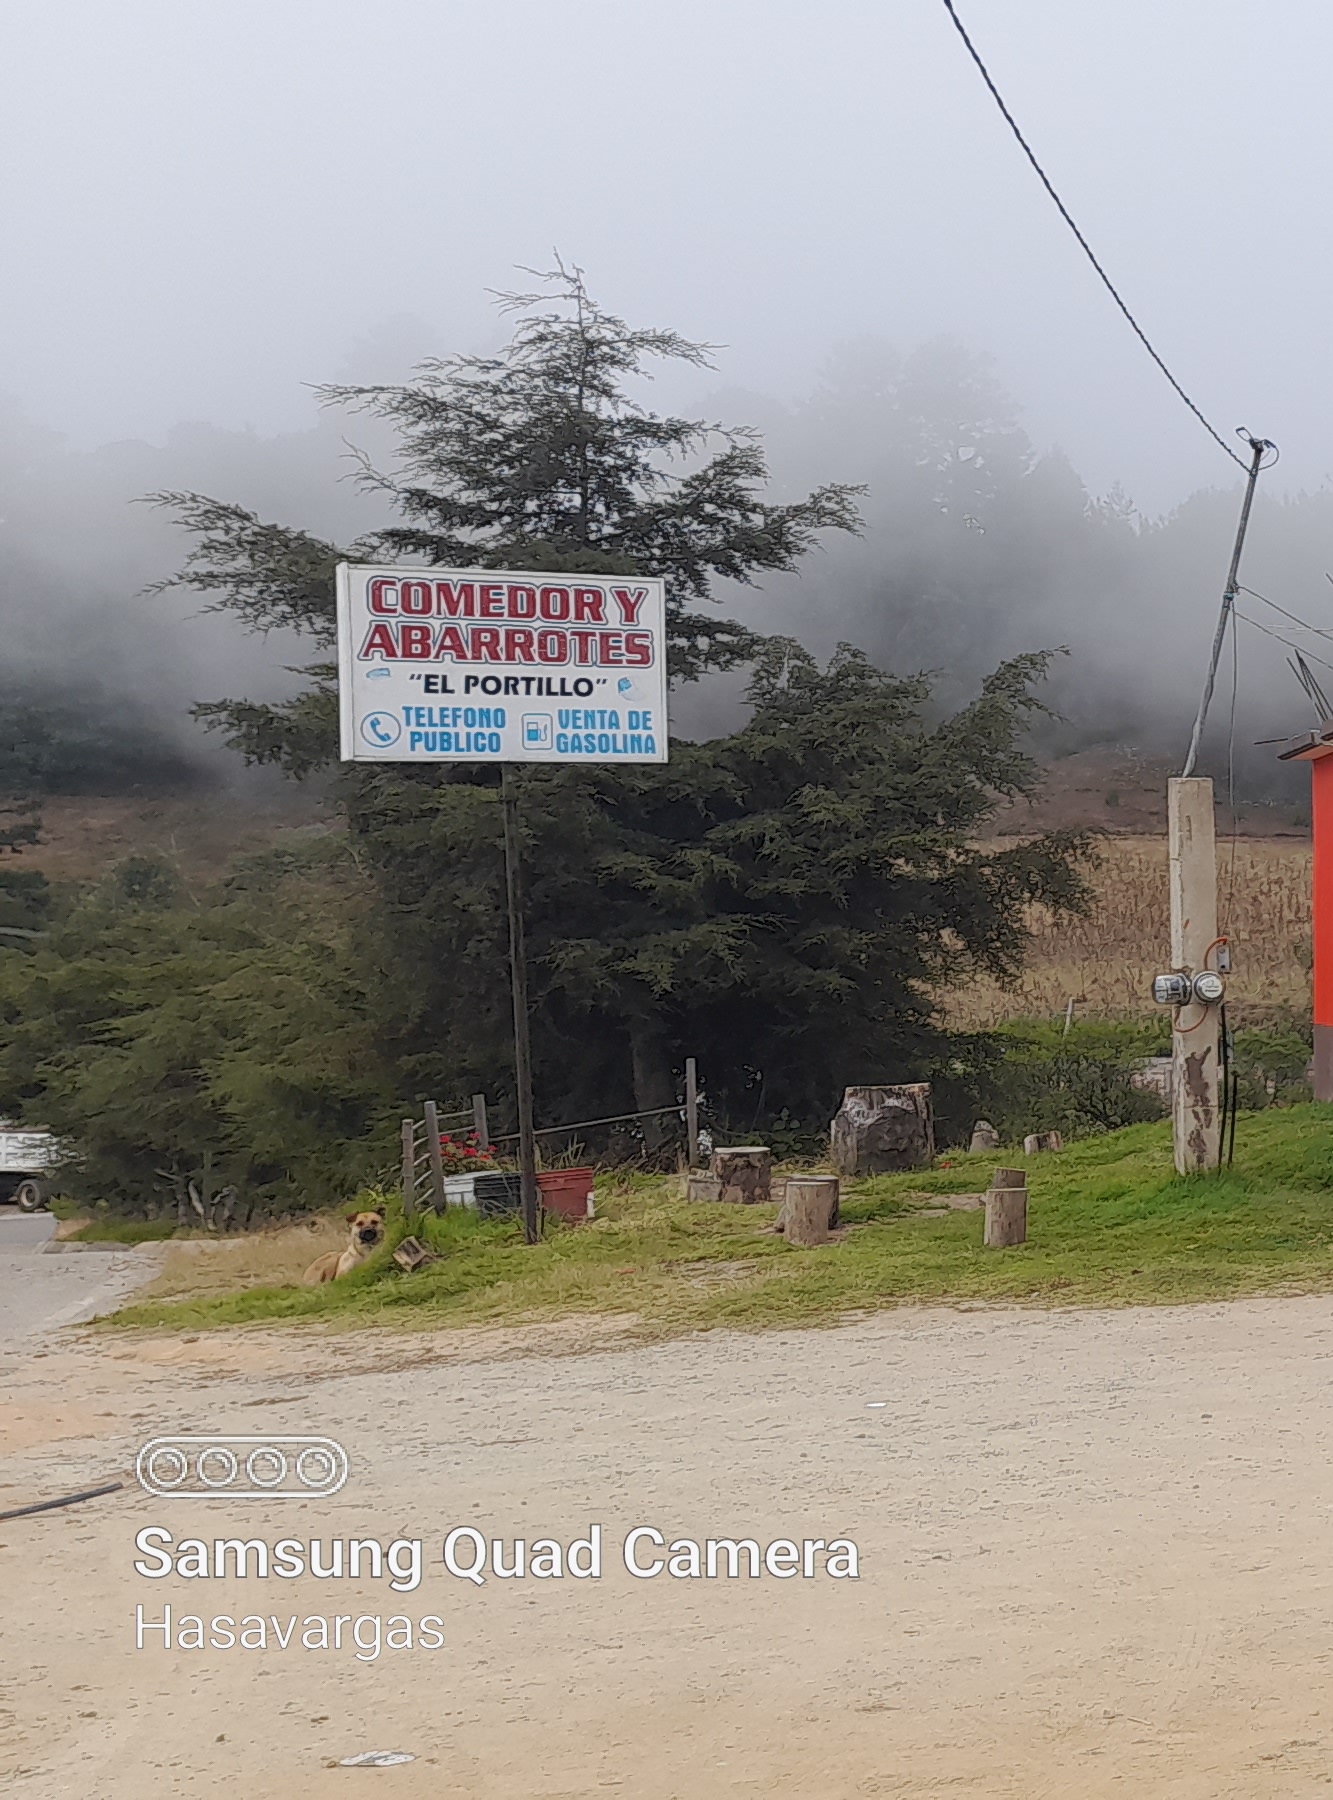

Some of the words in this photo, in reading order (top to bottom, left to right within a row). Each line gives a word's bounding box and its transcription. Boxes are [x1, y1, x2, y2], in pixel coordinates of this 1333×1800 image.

[368, 577, 607, 625] COMEDOR
[613, 587, 650, 626] Y
[359, 621, 655, 668] ABARROTES
[402, 706, 506, 729] TELEFONO
[558, 709, 620, 730] VENTA
[628, 711, 652, 731] DE
[410, 731, 501, 753] PUBLICO
[556, 733, 657, 754] GASOLINA
